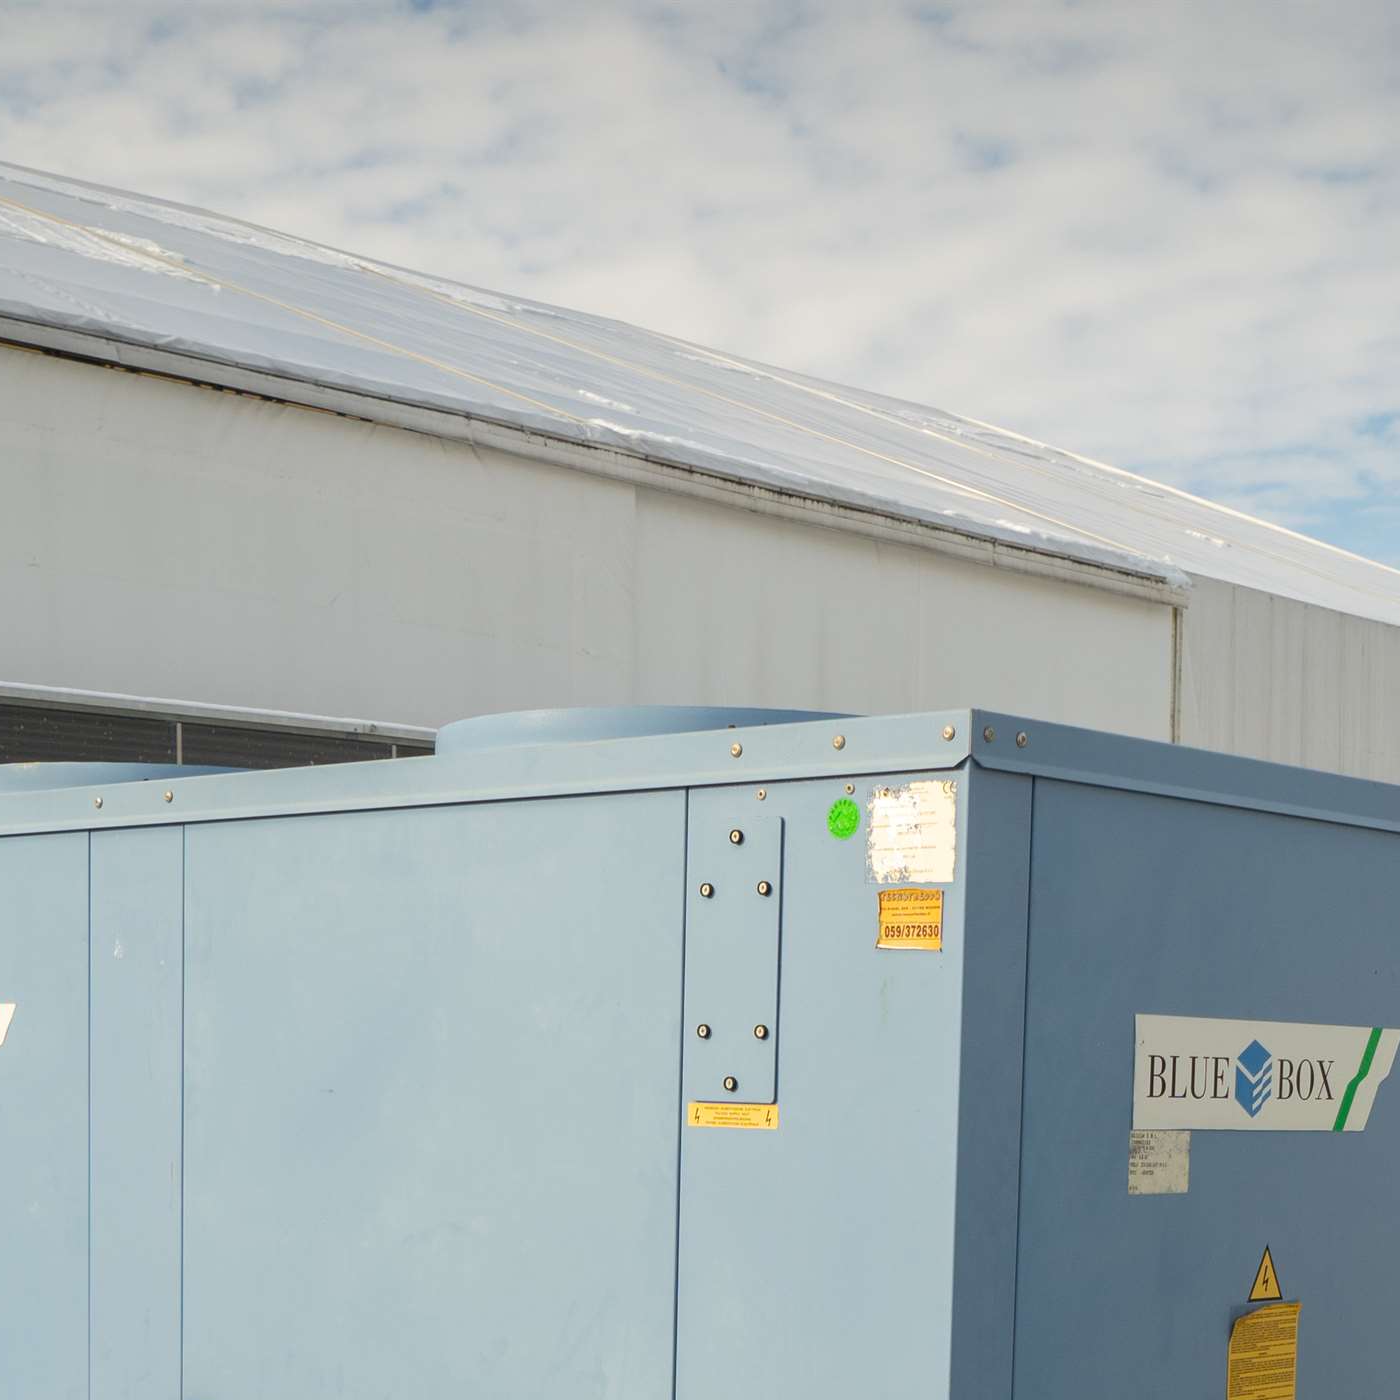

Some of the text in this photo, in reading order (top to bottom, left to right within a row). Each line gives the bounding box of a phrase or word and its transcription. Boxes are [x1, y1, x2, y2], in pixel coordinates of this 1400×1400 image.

[885, 925, 939, 938] 059/372630
[1147, 1055, 1335, 1101] BLUE BOX
